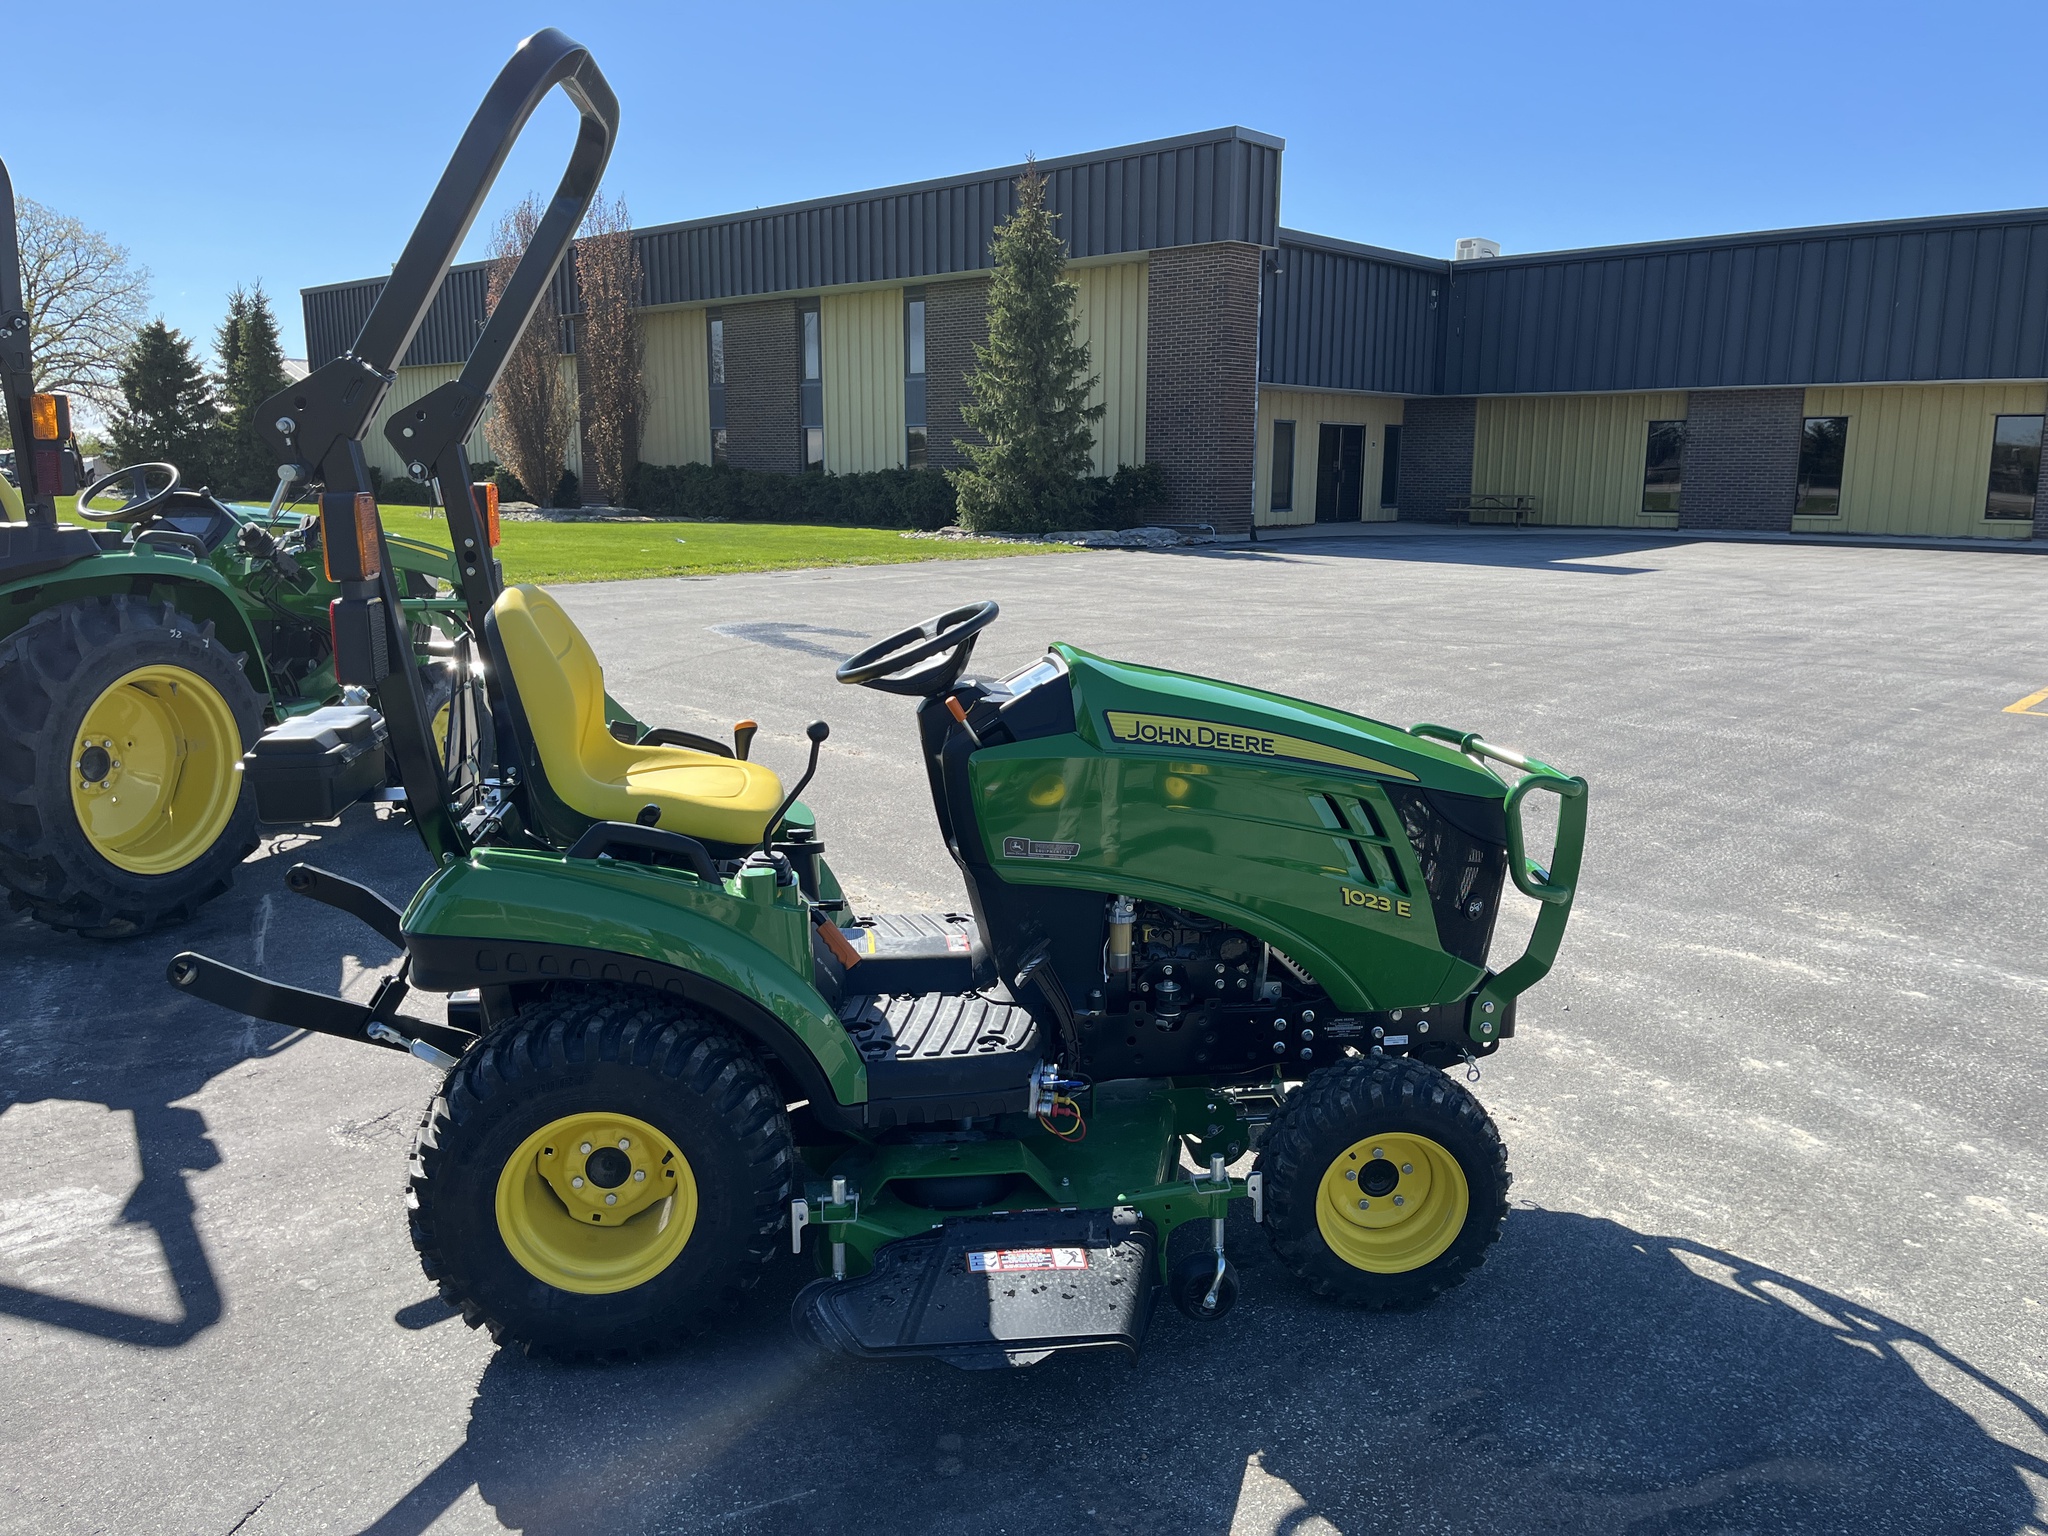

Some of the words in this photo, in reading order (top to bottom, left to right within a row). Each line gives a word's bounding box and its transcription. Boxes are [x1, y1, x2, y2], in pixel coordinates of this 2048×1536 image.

[1127, 720, 1191, 743] JOHN
[1197, 726, 1275, 753] DEERE
[1341, 886, 1391, 911] 1023
[1396, 900, 1411, 917] E
